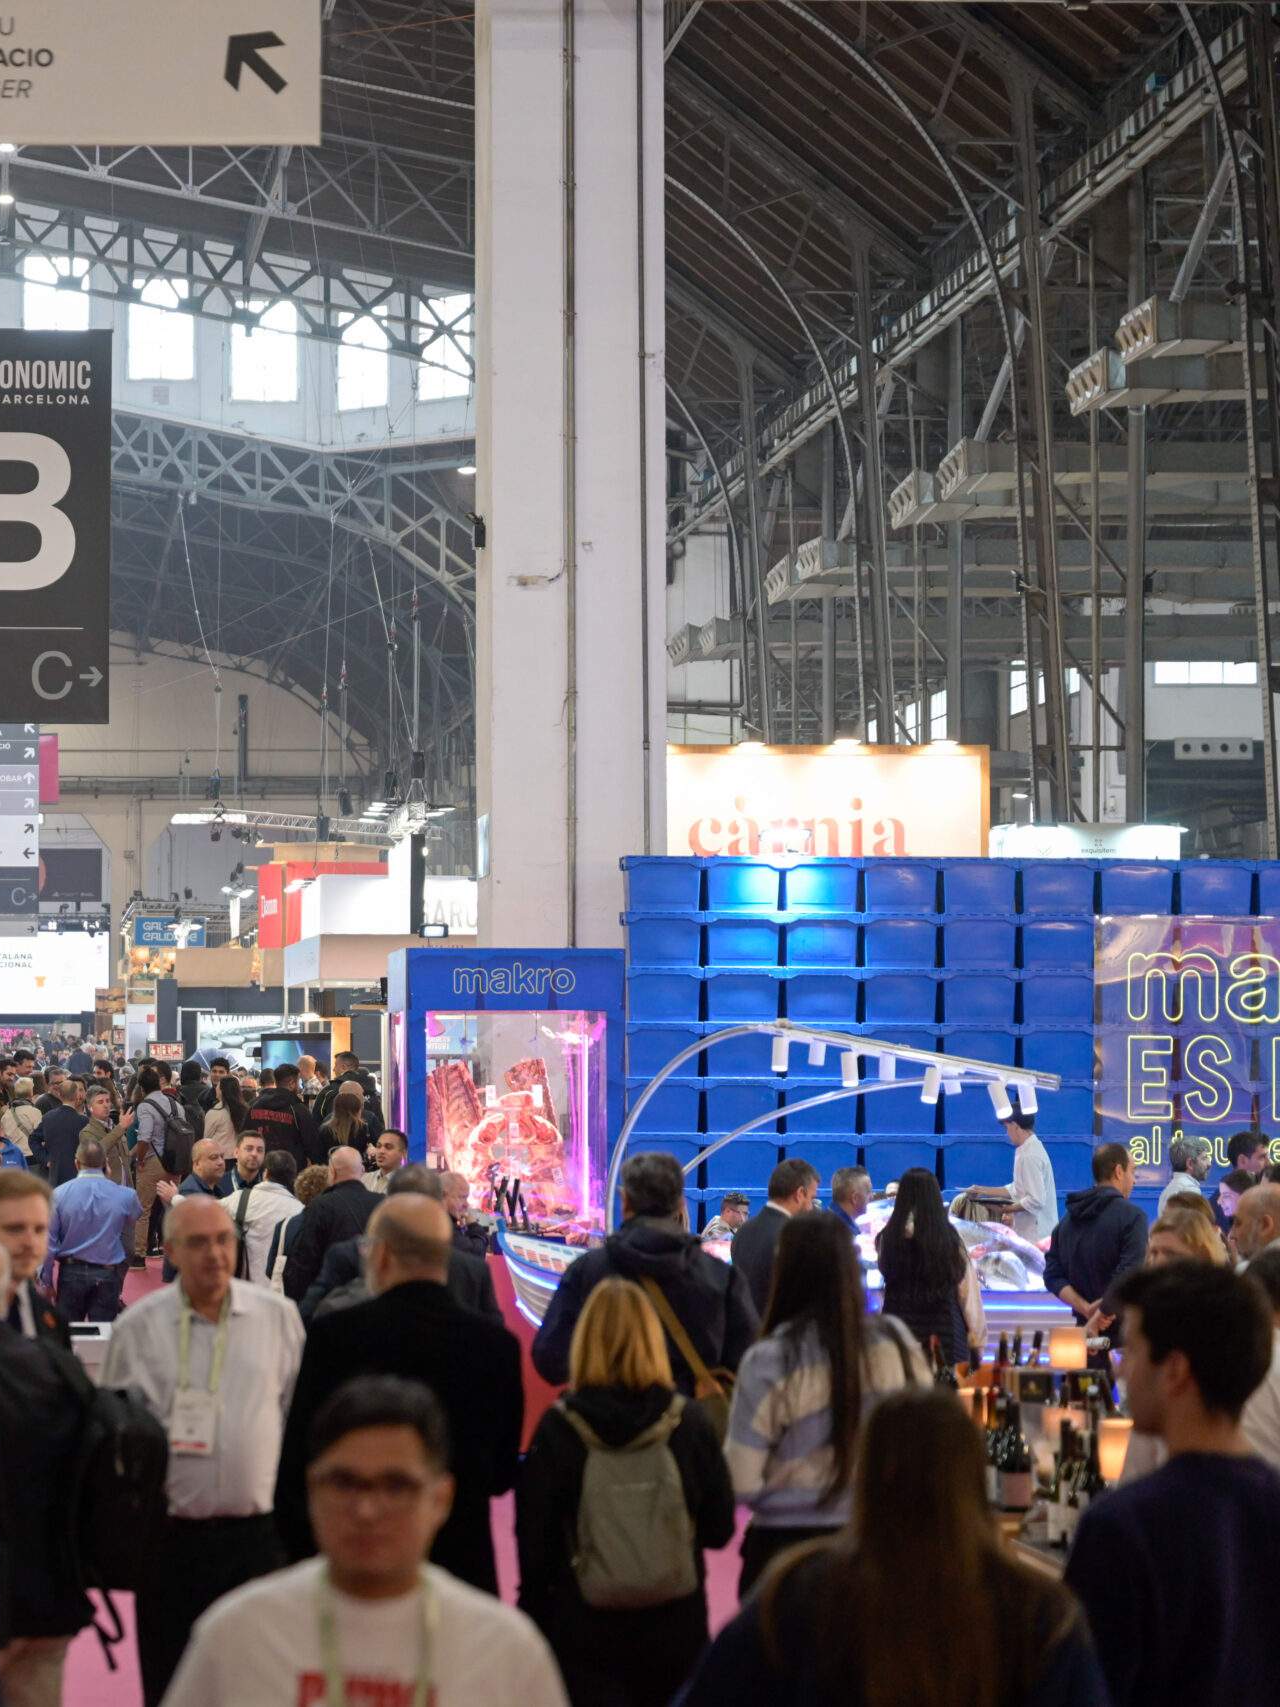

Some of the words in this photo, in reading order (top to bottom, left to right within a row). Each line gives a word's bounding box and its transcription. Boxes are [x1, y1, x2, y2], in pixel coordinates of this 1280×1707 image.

[31, 650, 74, 700] C
[11, 887, 26, 905] C
[453, 962, 576, 995] makro
